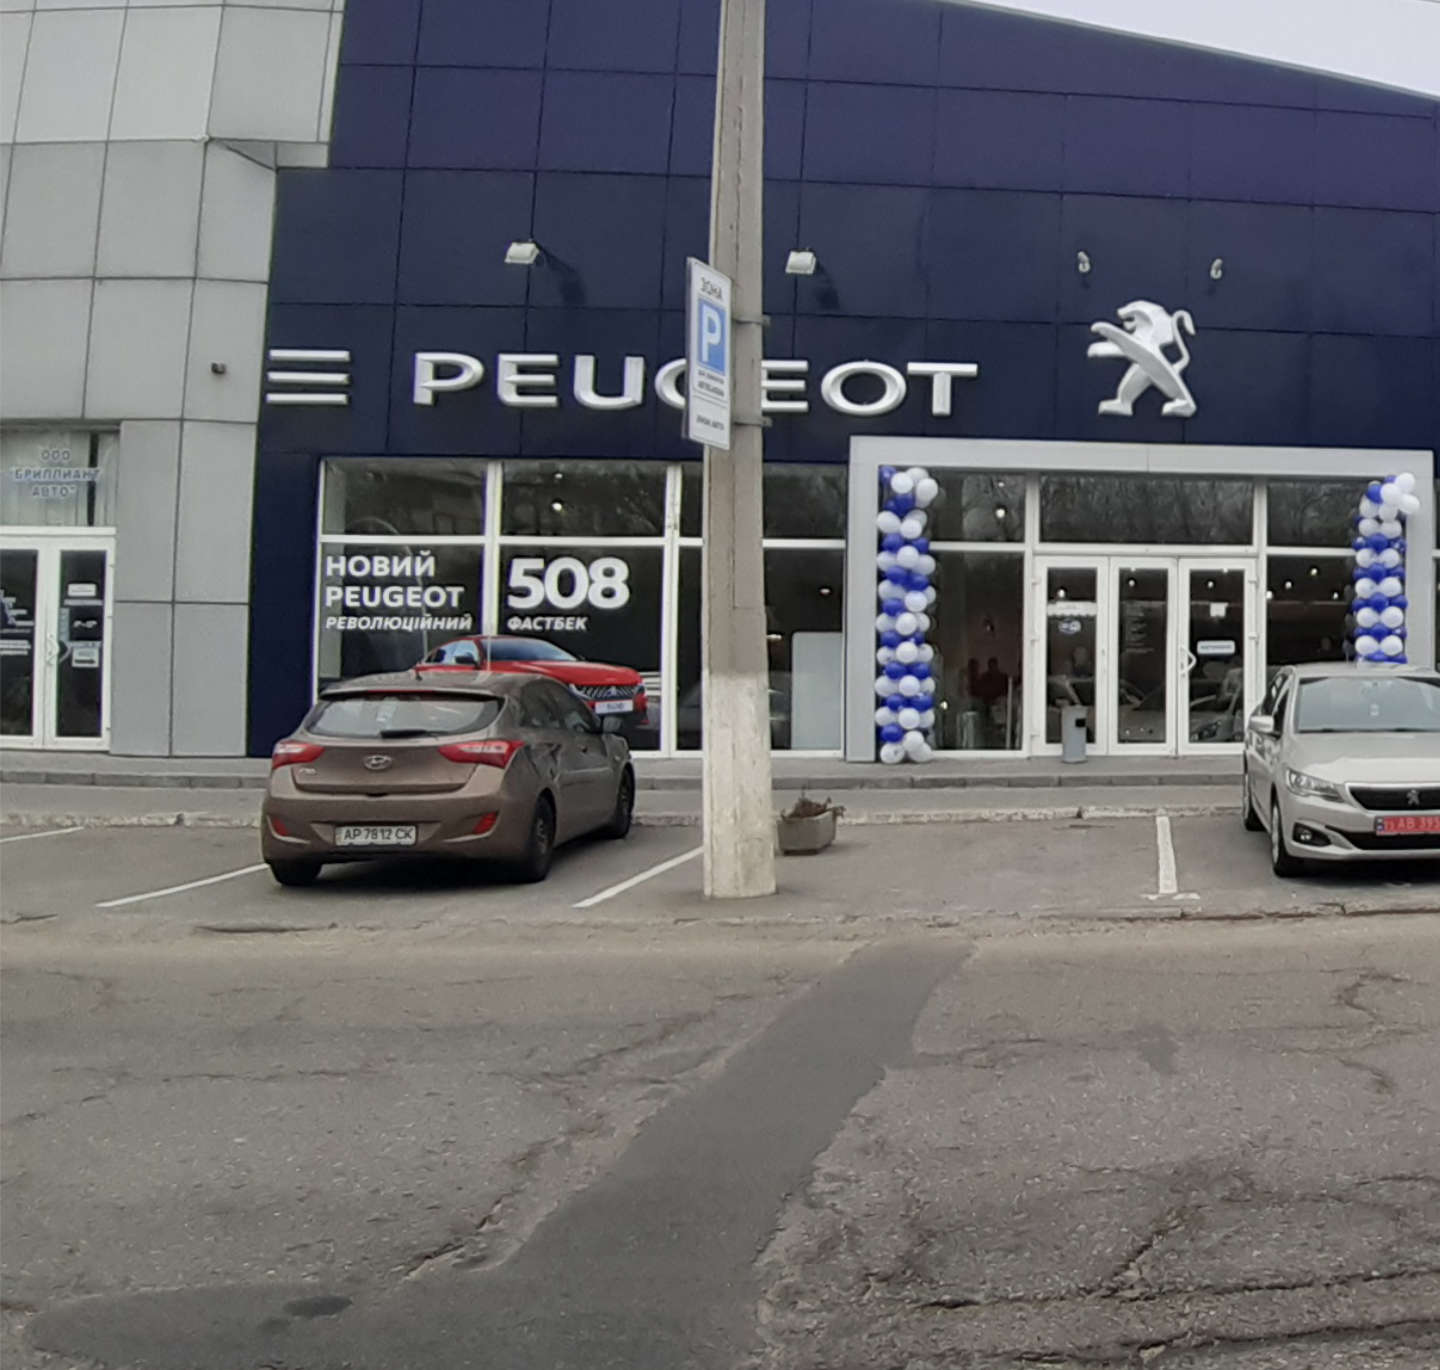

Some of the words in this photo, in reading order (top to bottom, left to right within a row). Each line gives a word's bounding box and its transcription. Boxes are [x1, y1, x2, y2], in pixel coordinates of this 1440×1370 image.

[702, 303, 722, 363] P
[41, 449, 71, 461] ООО
[326, 550, 435, 577] НОВИЙ
[508, 556, 630, 609] 508
[326, 585, 465, 607] PEUGEOT
[326, 613, 473, 631] РЕВОЛЮЦІЙНИЙ
[508, 615, 588, 631] ФАСТБЕК
[344, 828, 361, 840] AP
[395, 828, 413, 840] CK
